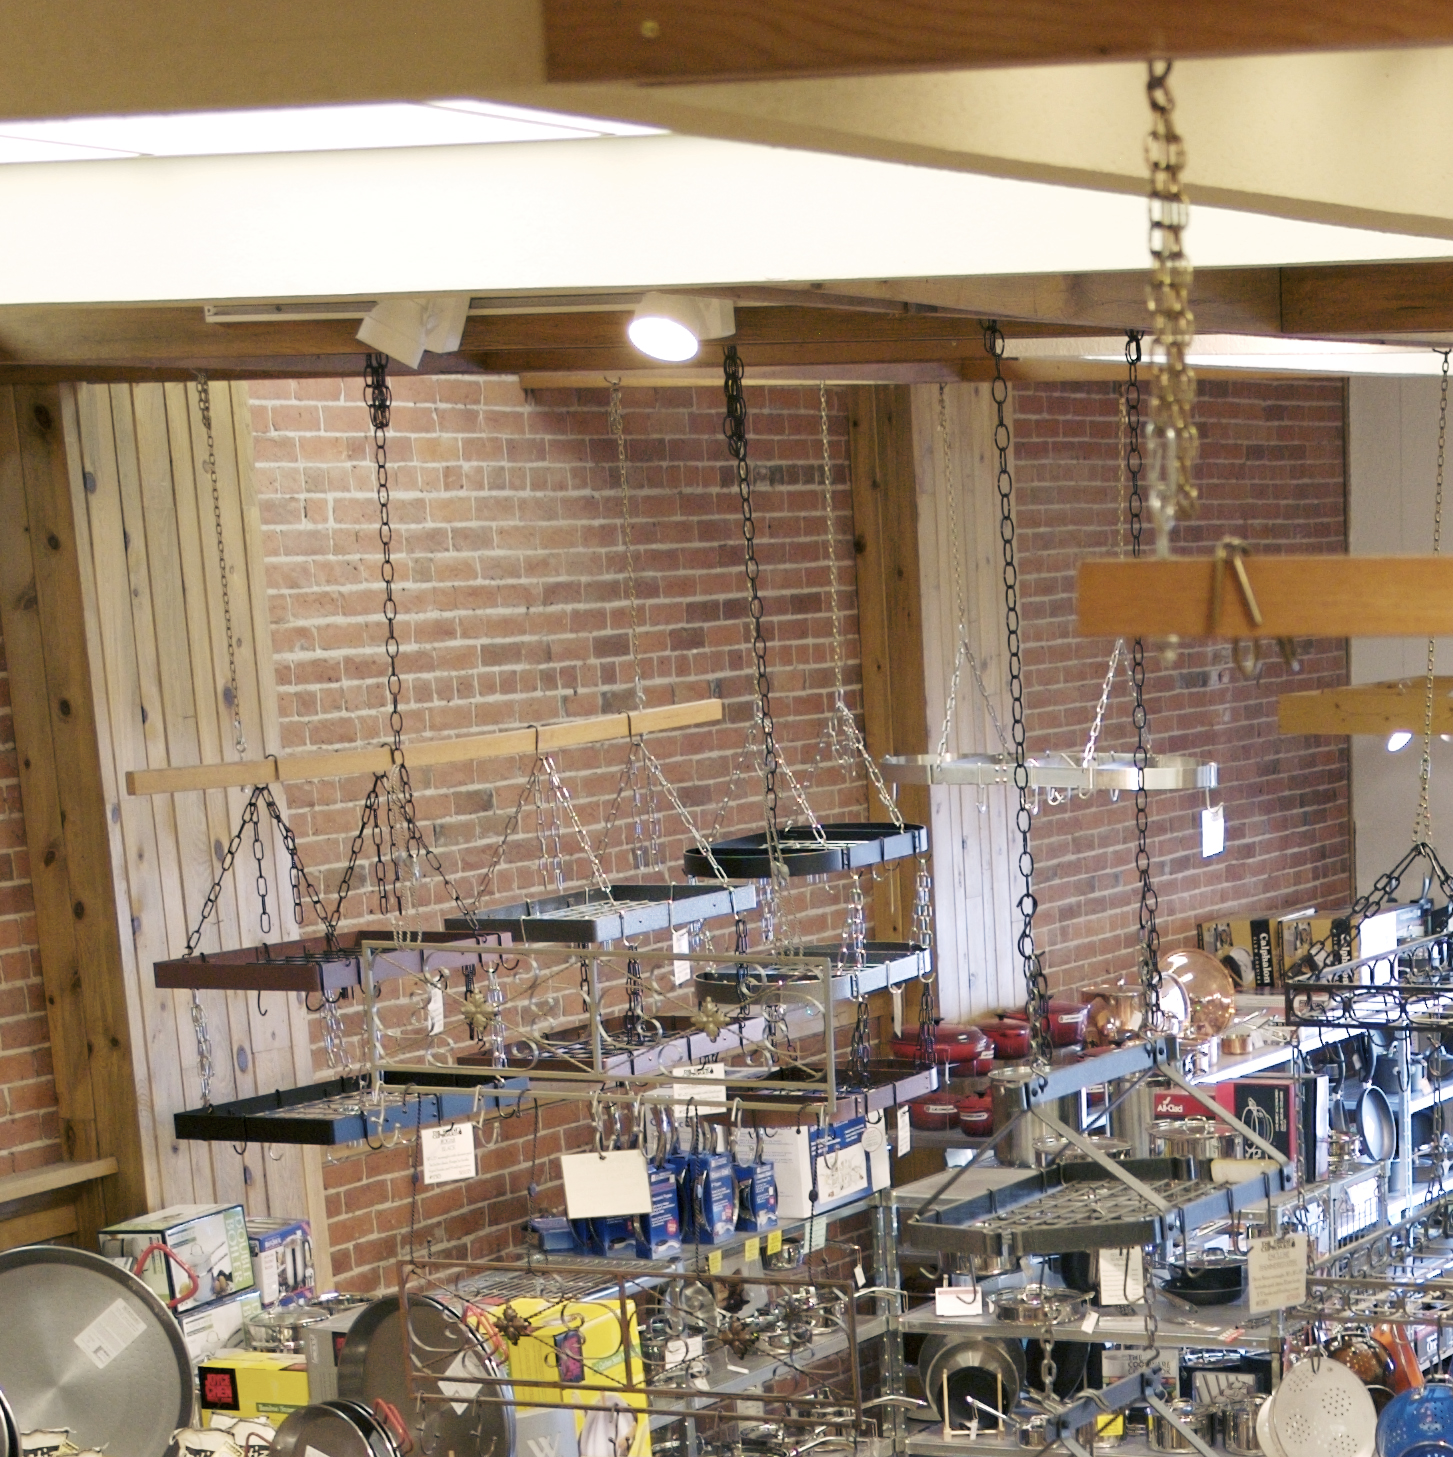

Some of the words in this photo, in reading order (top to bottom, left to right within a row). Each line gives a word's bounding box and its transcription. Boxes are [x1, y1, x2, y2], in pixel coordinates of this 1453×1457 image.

[1259, 932, 1270, 985] Calphalon
[1157, 1104, 1183, 1113] All-Clad
[225, 1218, 243, 1283] BOILER
[236, 1216, 250, 1279] DOUBLE
[205, 1385, 233, 1399] CHEN
[206, 1374, 231, 1386] JOYCE
